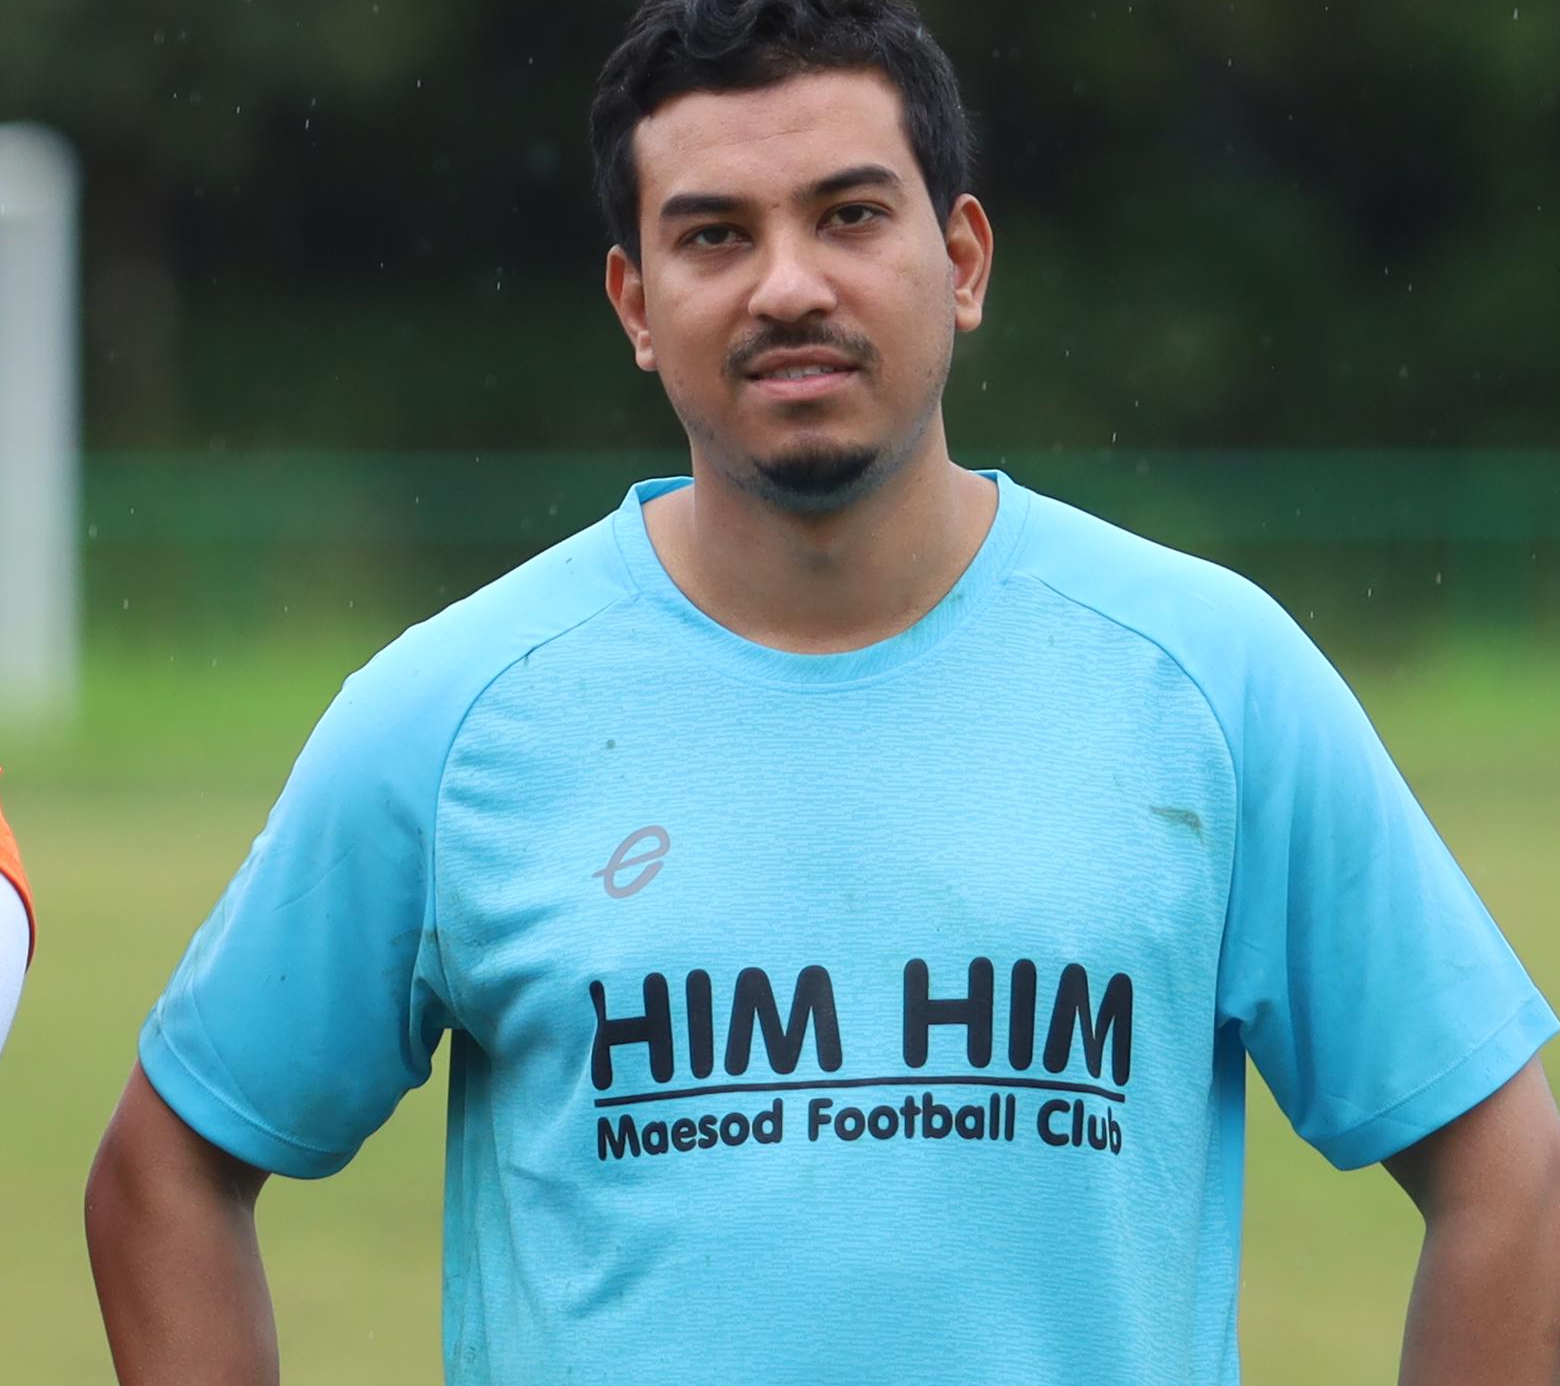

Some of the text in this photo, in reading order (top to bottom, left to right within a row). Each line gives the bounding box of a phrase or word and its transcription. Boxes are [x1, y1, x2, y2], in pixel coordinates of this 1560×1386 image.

[589, 957, 1133, 1090] HIM HIM
[597, 1092, 1122, 1160] Maesod Football Club
